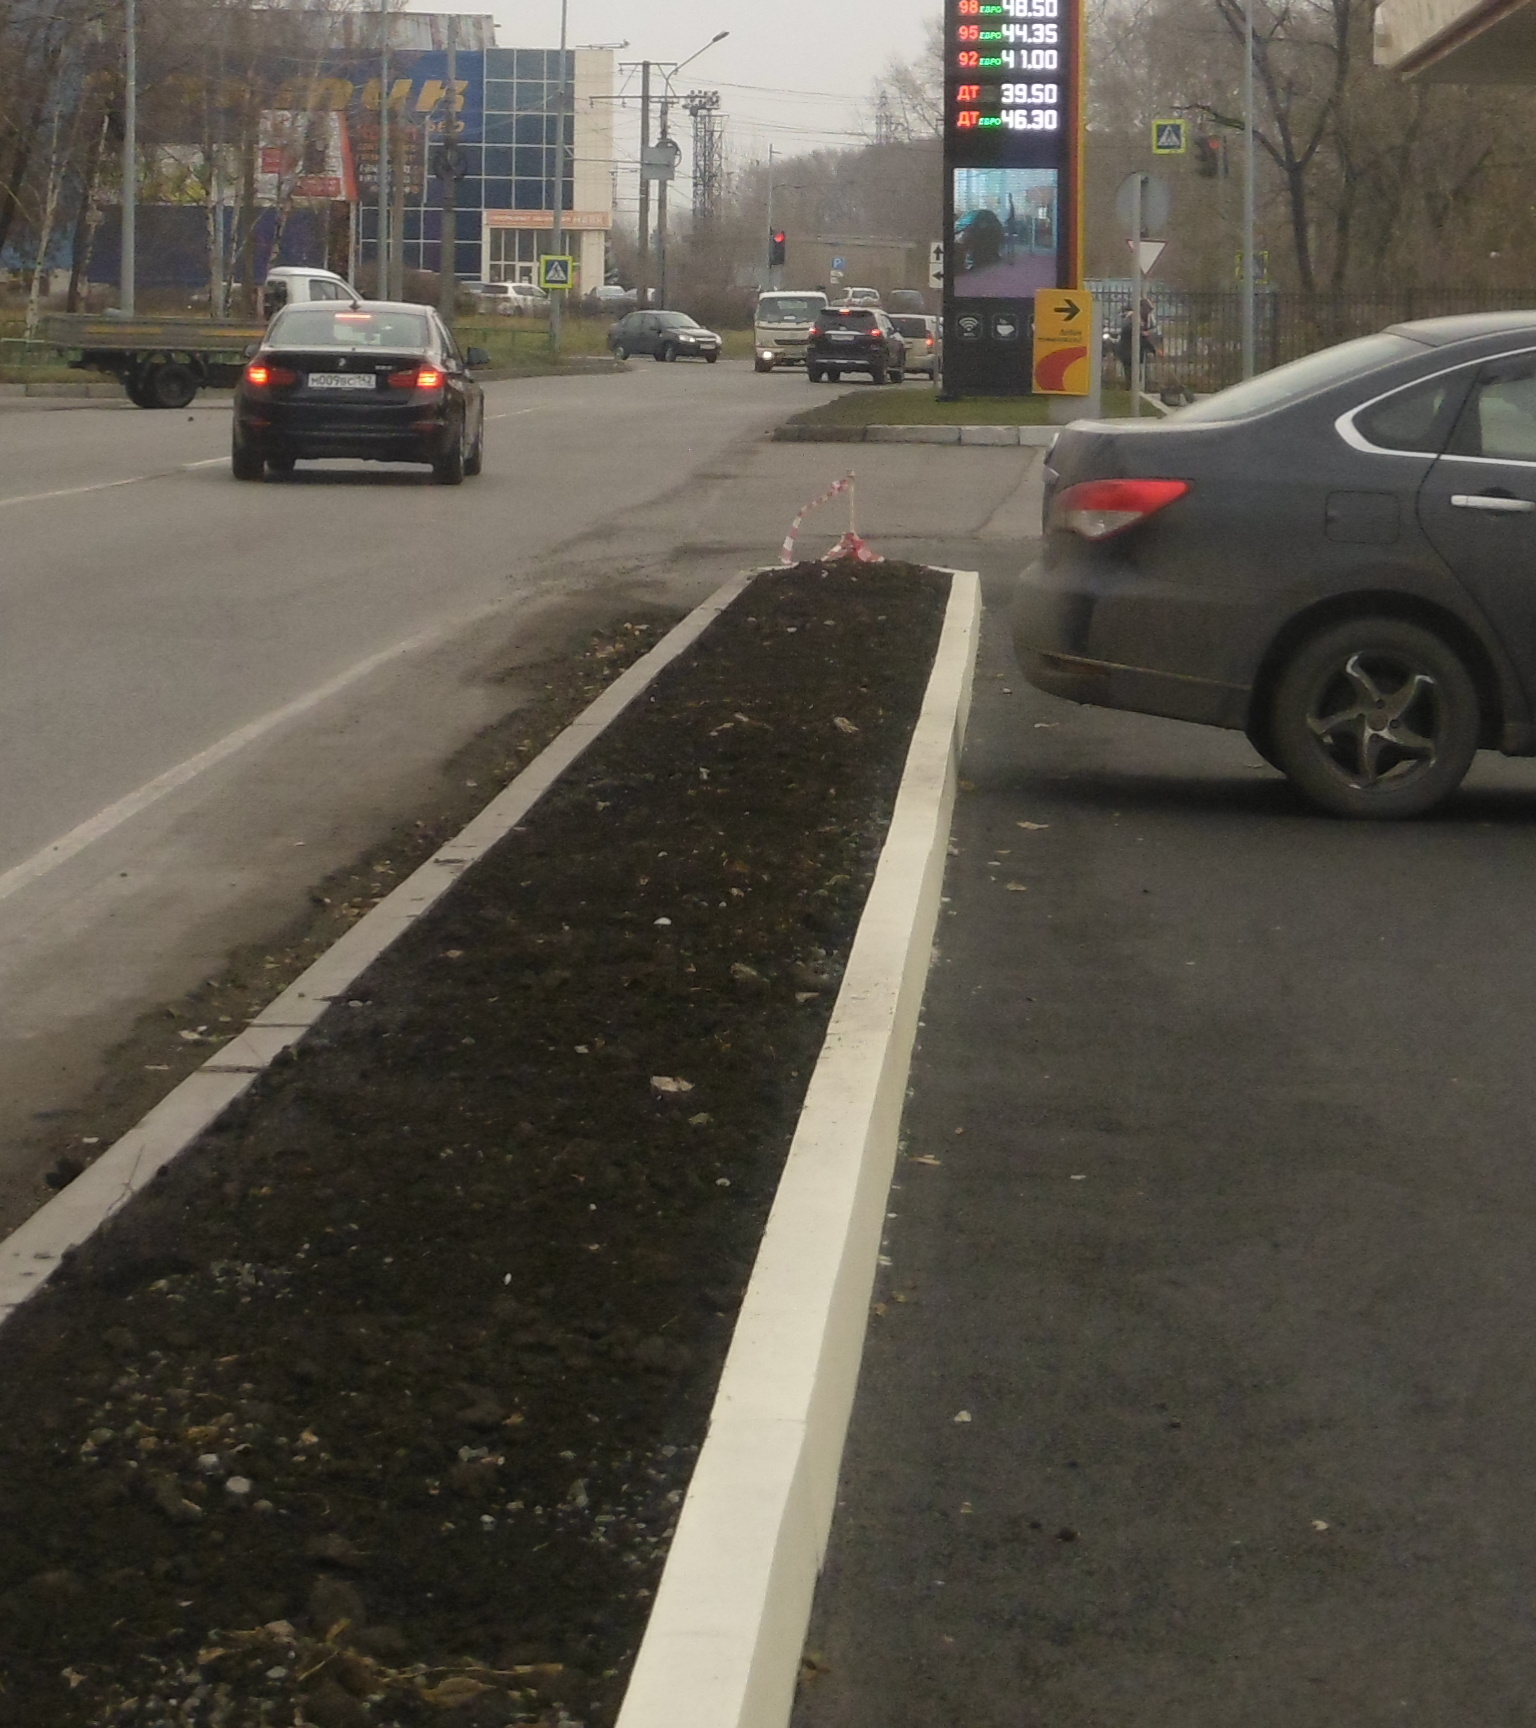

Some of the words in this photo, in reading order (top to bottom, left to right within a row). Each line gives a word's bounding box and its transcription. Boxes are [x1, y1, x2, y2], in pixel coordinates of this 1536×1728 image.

[958, 0, 979, 14] 98
[958, 25, 979, 40] 95
[1002, 24, 1058, 43] 44.35
[958, 52, 979, 67] 92
[957, 85, 980, 101] ДТ
[1001, 84, 1058, 103] 39.50
[957, 112, 980, 127] ДТ
[1001, 110, 1058, 129] 46.30
